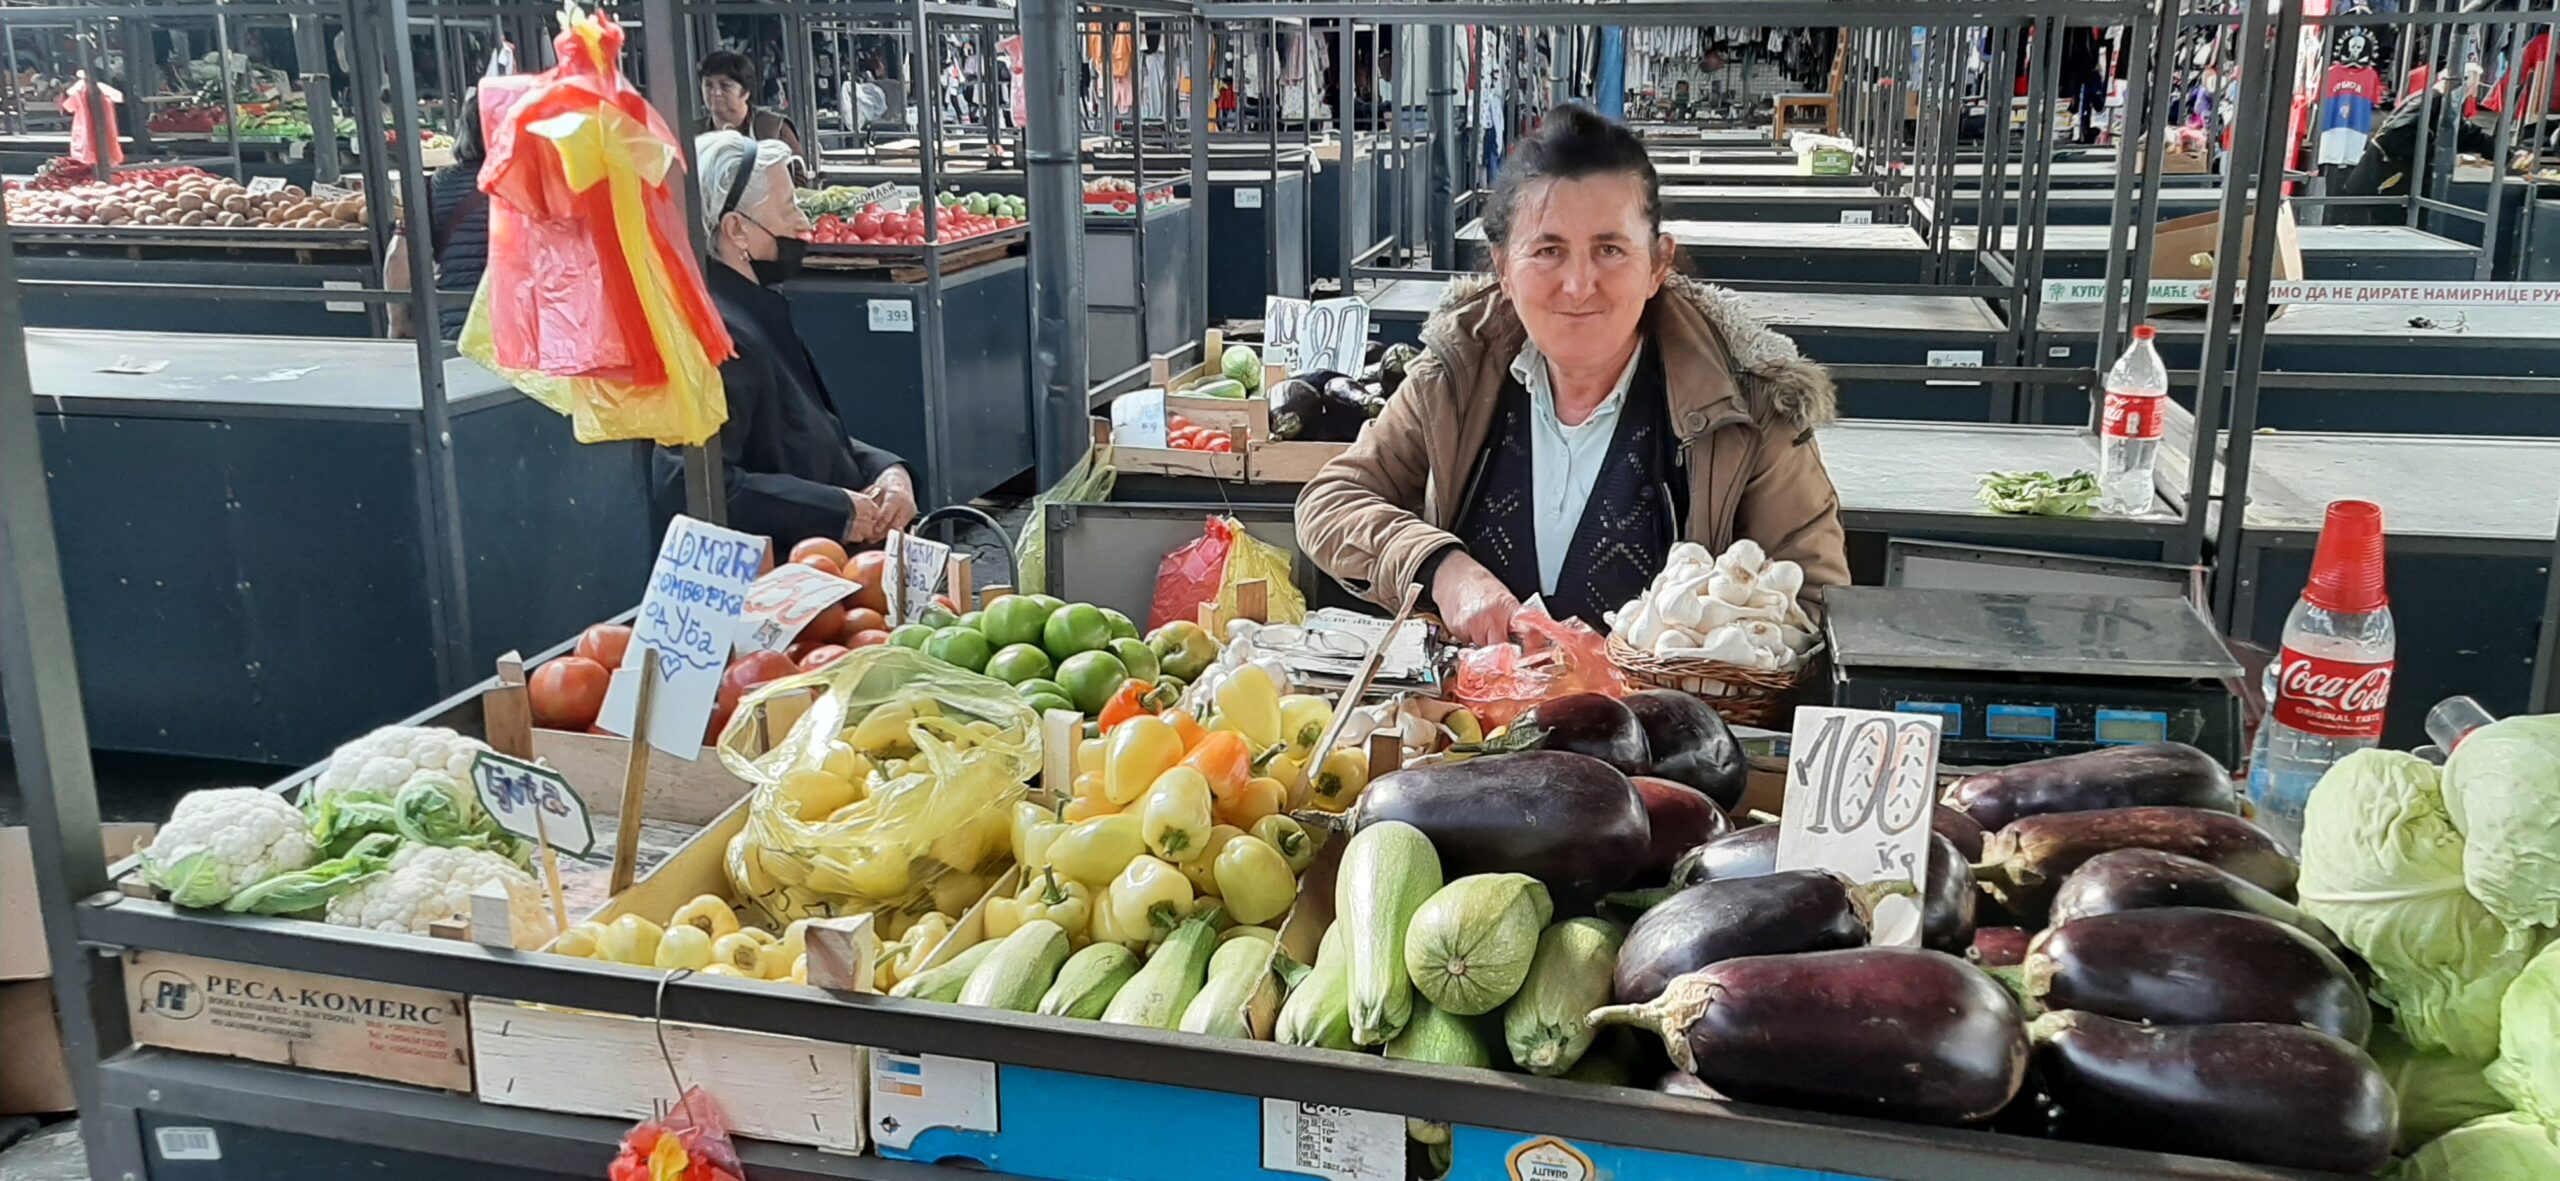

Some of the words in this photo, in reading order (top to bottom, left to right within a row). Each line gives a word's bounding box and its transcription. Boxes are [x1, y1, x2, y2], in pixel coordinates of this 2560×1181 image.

[2306, 287, 2329, 300] ДА
[2332, 287, 2353, 299] НЕ
[2356, 288, 2419, 301] ДИРАТЕ
[2424, 288, 2529, 304] НАМИРНИЦЕ
[886, 310, 909, 322] 393
[2281, 660, 2393, 711] Coca-Cola
[2295, 706, 2351, 723] ORIGINAL
[1795, 715, 1938, 836] 100
[206, 974, 443, 1025] PECA-KOMERC
